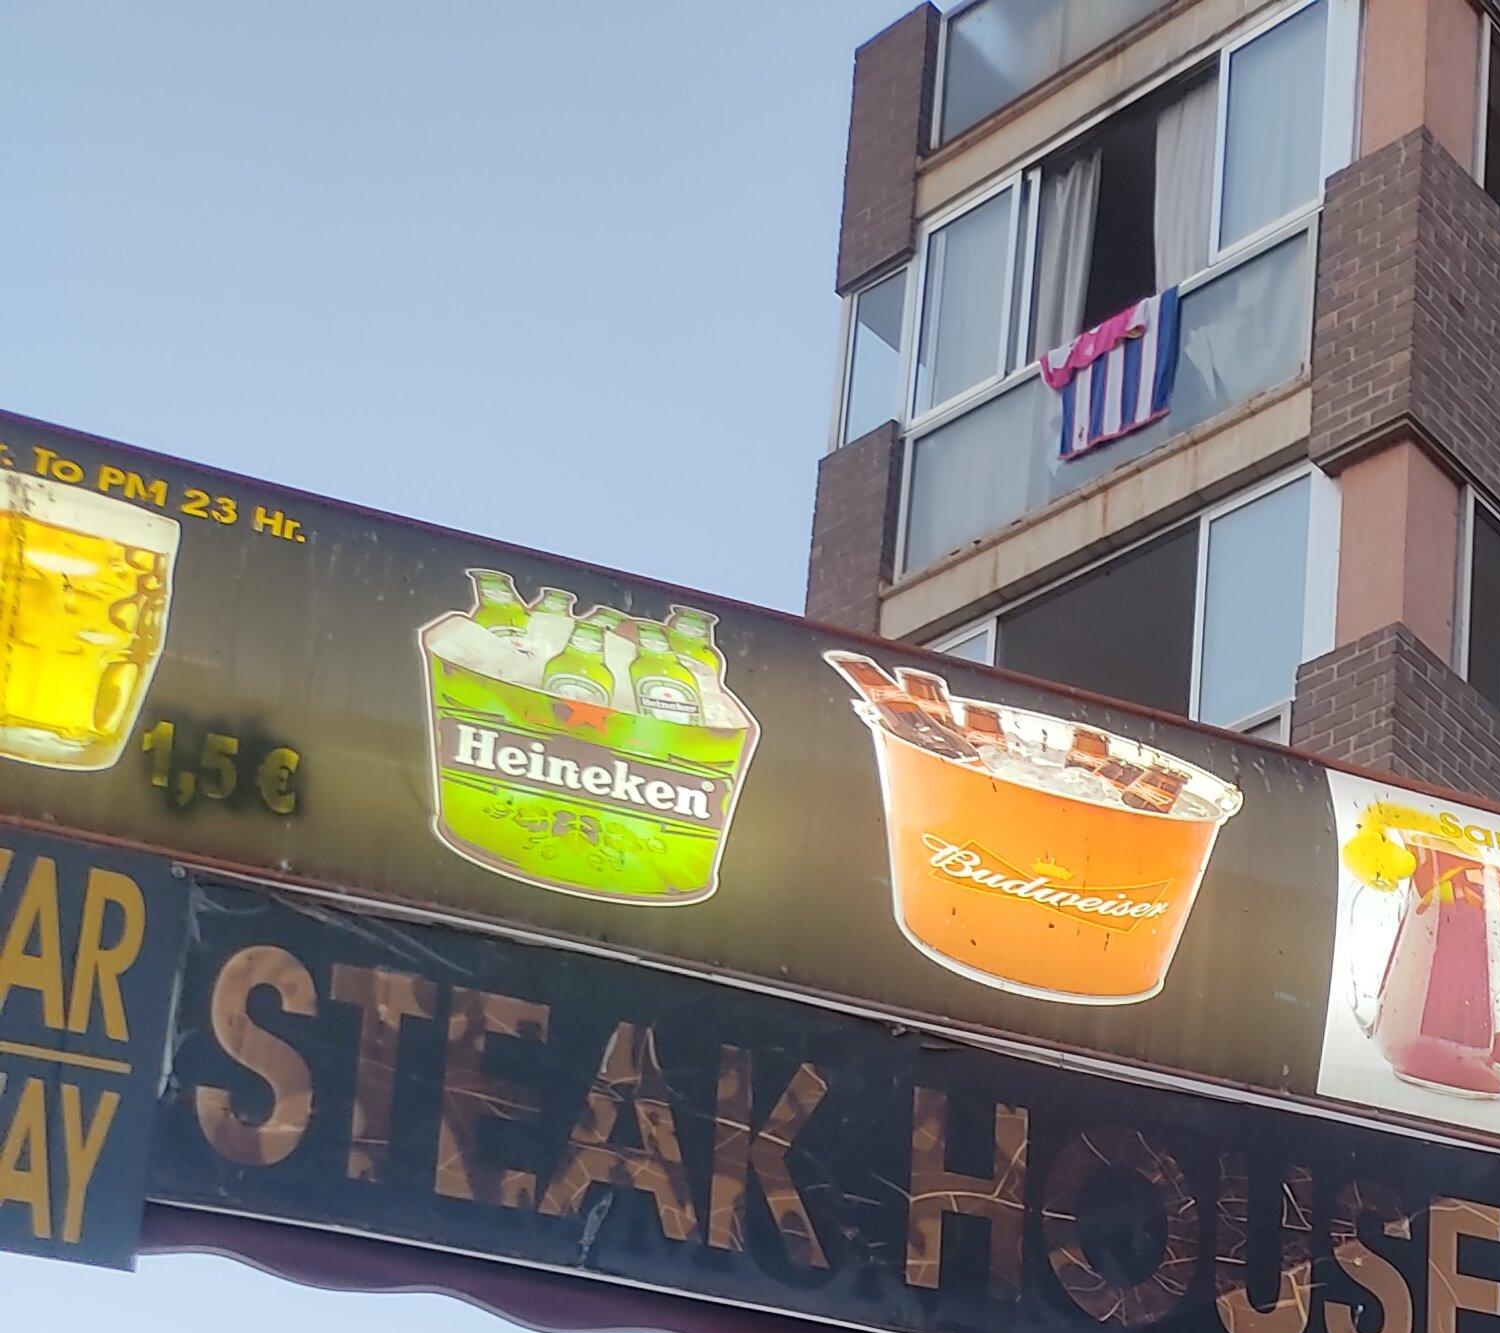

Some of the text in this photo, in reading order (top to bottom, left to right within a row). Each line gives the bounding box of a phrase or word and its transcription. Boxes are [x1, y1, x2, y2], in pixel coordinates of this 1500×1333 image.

[33, 446, 84, 484] To
[97, 464, 168, 507] PM
[181, 488, 239, 525] 23
[253, 506, 306, 543] Hr.
[140, 719, 302, 813] 1,5 €
[454, 723, 711, 819] Heineken
[921, 833, 1170, 921] Budweiser
[193, 945, 834, 1274] STEAK
[0, 1072, 121, 1244] AY
